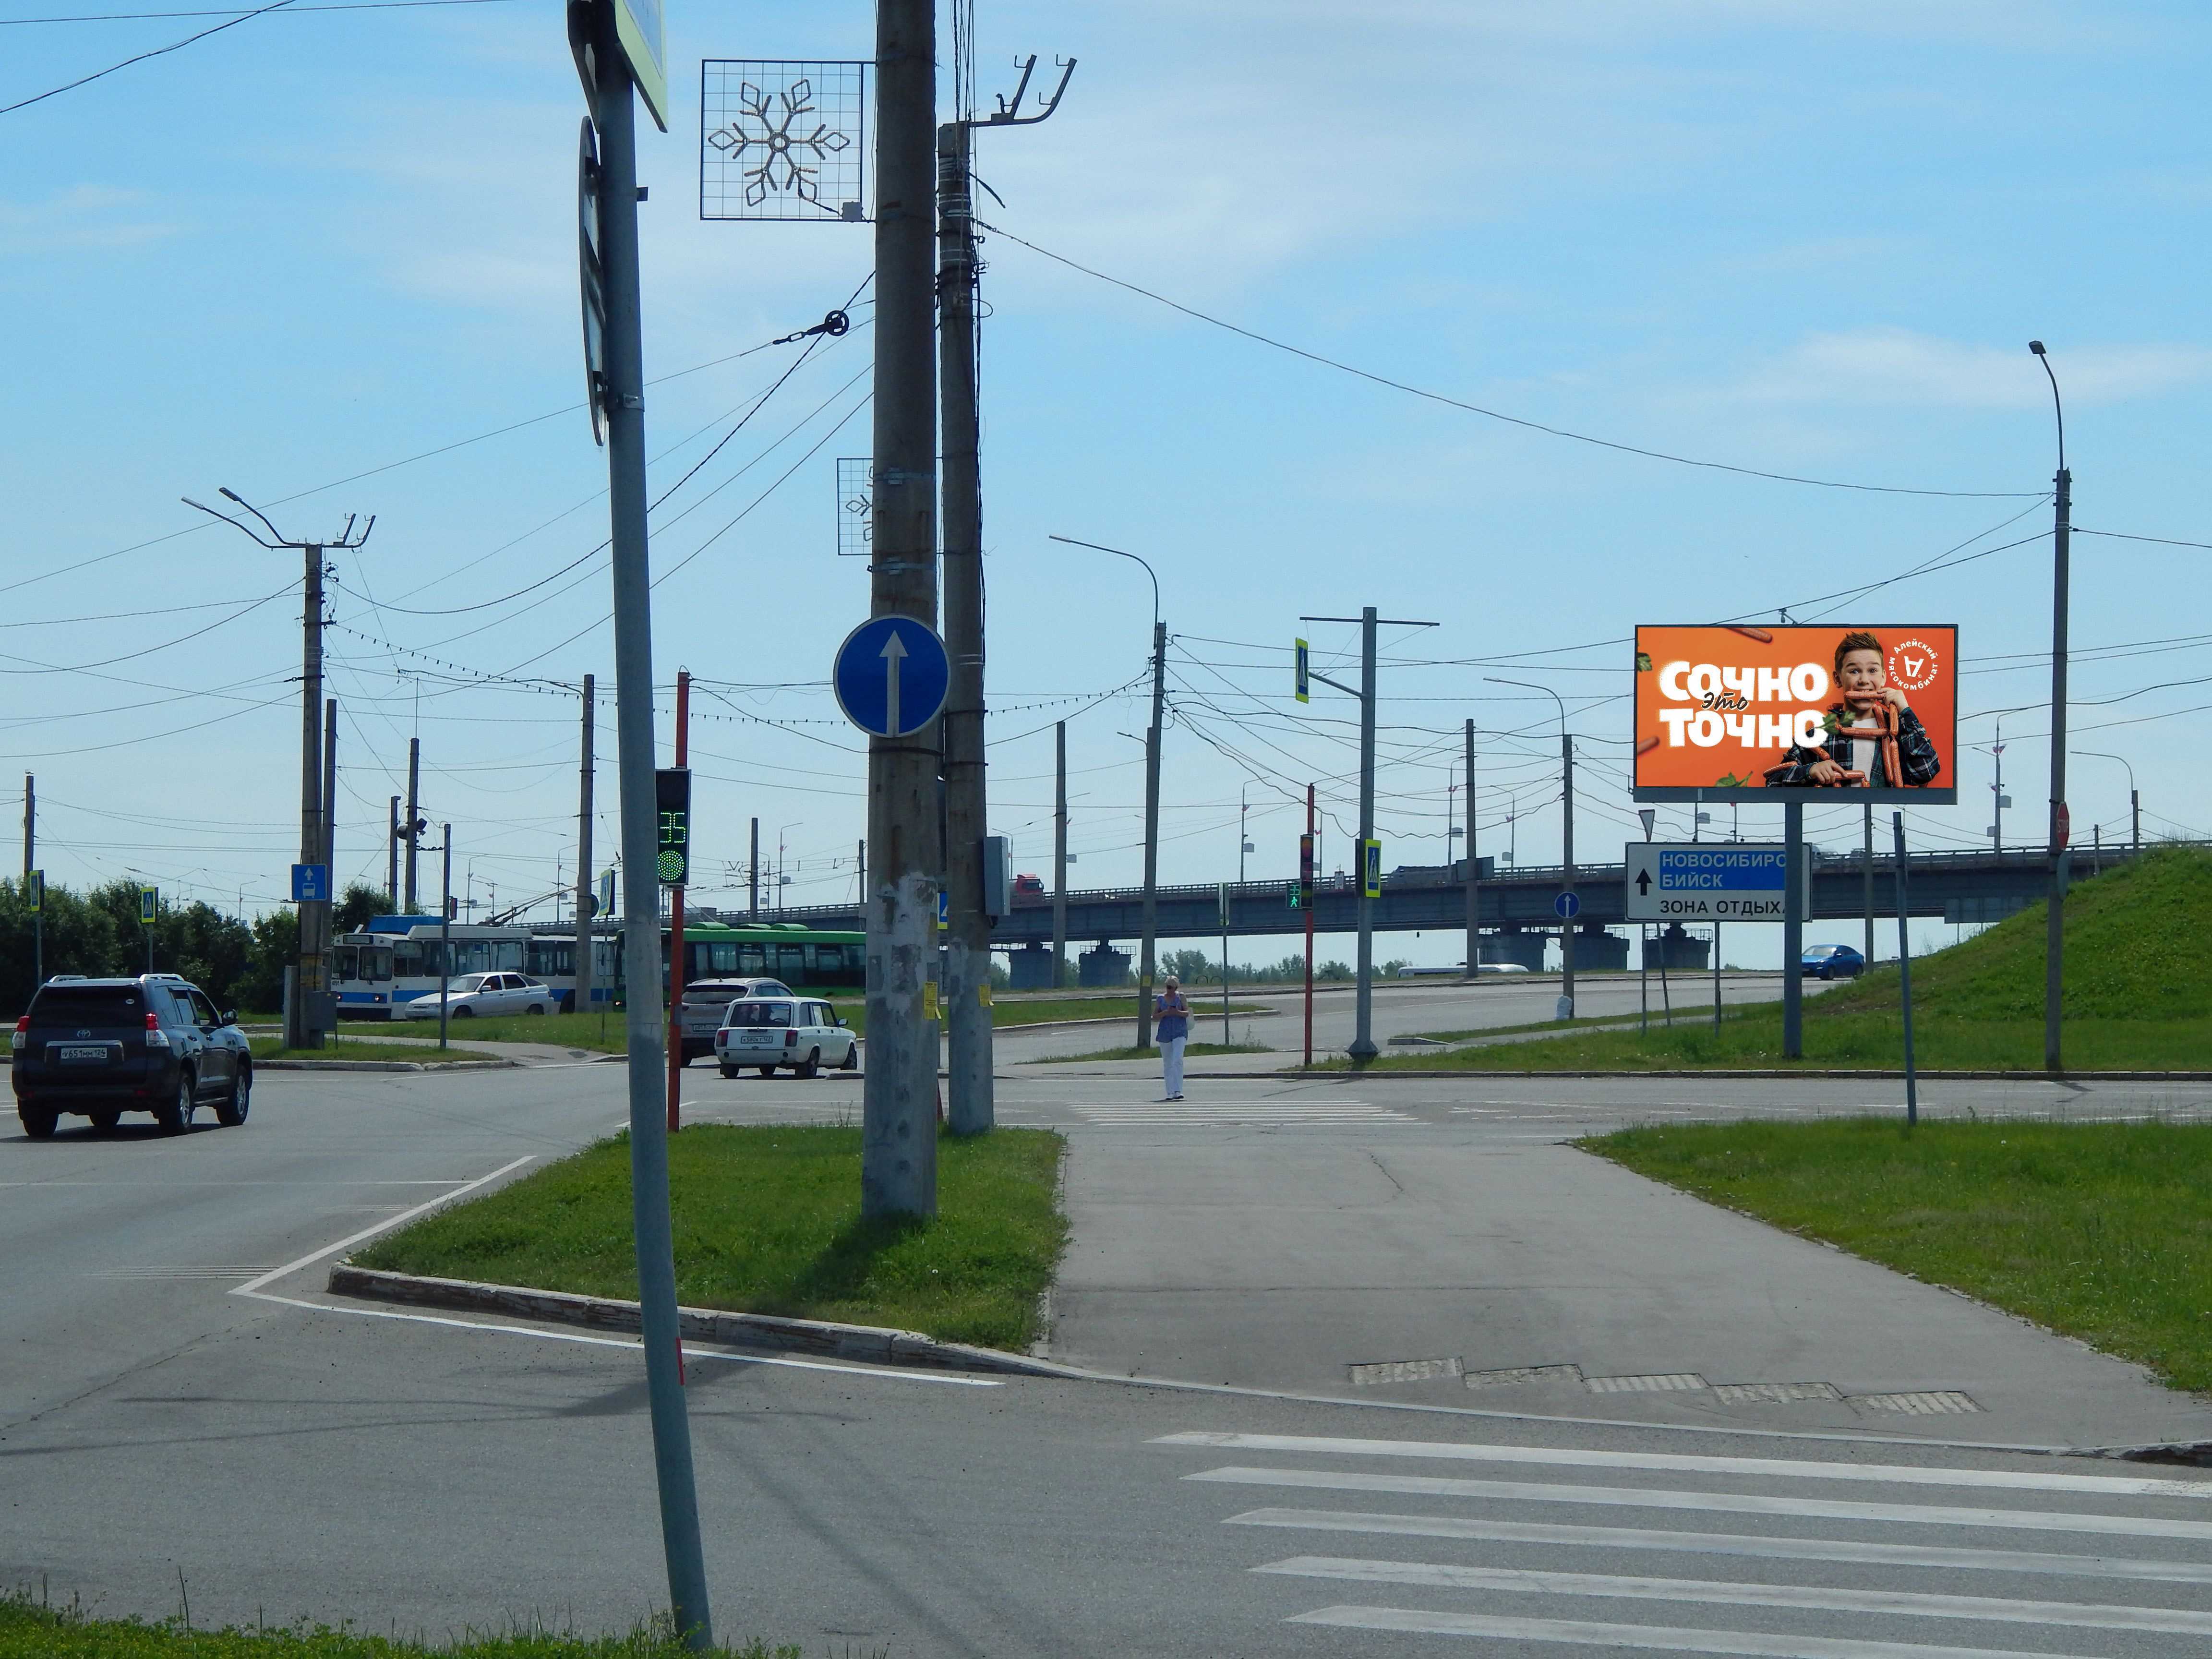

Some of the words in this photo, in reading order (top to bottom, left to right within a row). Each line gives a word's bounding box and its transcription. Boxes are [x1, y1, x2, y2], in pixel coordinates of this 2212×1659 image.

[1894, 638, 1938, 660] Алейский
[1659, 661, 1828, 702] СОЧНО
[1889, 657, 1938, 690] мясокомбинат
[1701, 692, 1749, 711] это
[1659, 708, 1828, 748] ТОЧНО
[660, 812, 685, 843] 35
[2058, 819, 2068, 833] STOP
[1662, 854, 1786, 867] НОВОСИБИРС
[1662, 872, 1723, 887] БИЙСК
[1660, 900, 1708, 913] ЗОНА
[1716, 901, 1785, 916] ОТДЫХ
